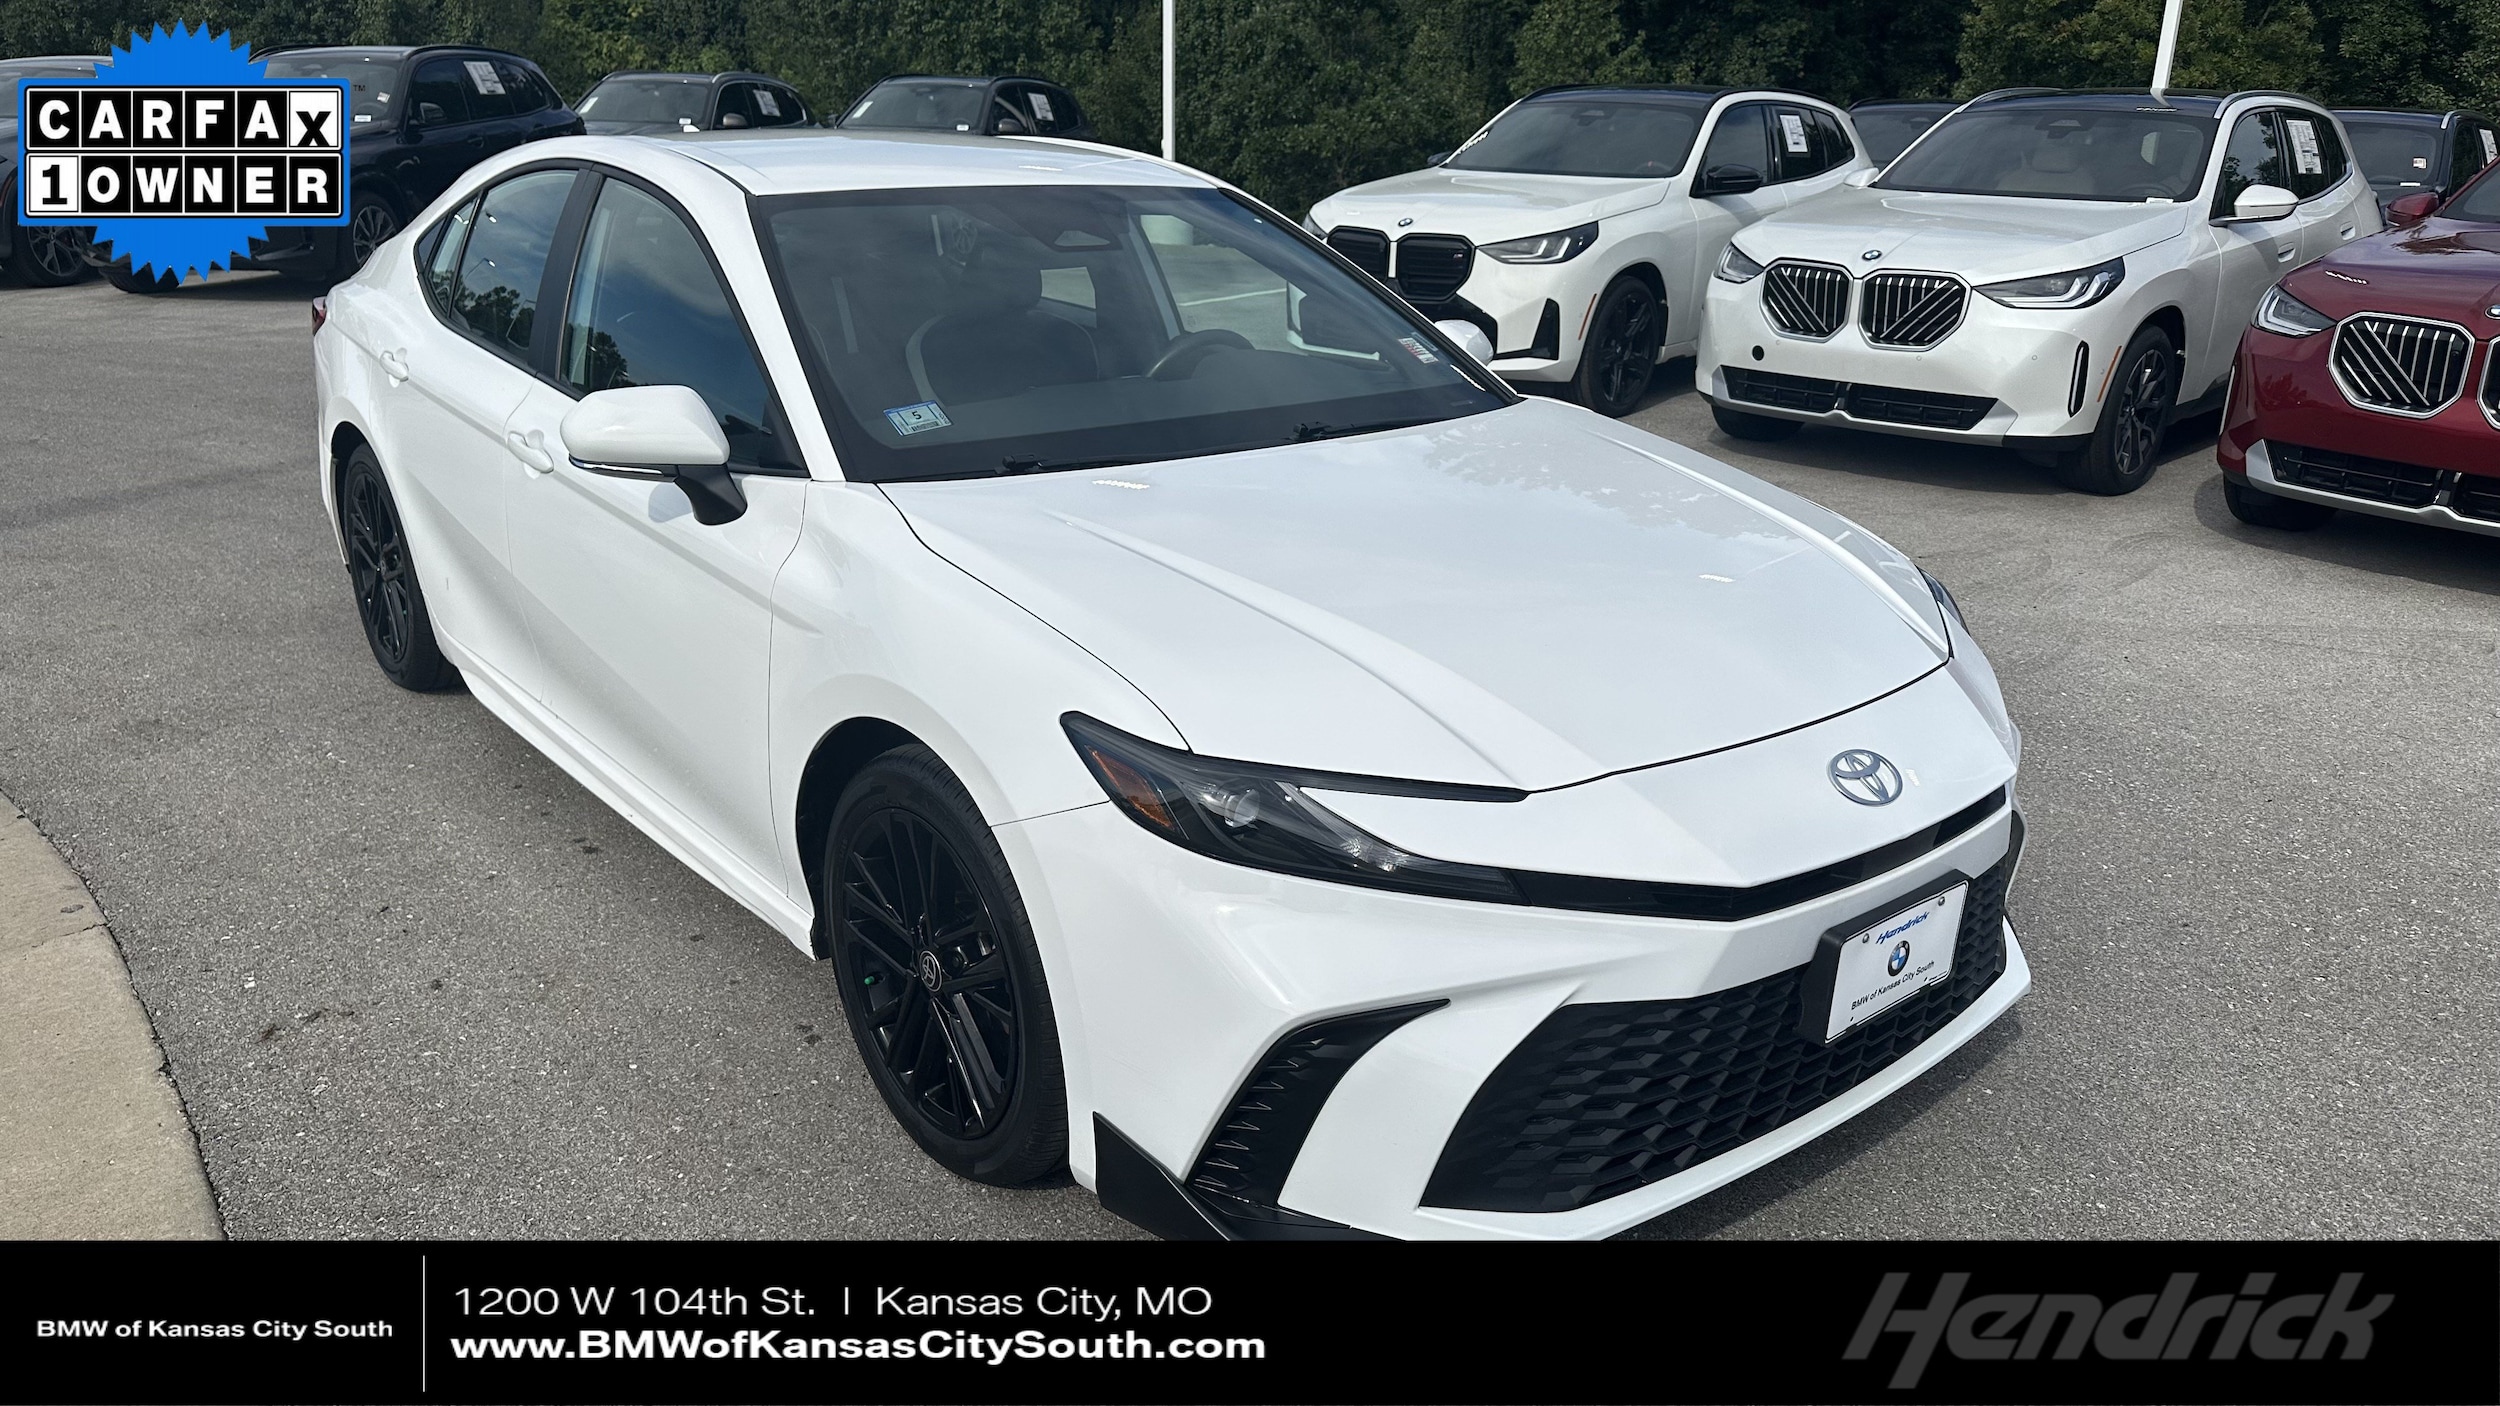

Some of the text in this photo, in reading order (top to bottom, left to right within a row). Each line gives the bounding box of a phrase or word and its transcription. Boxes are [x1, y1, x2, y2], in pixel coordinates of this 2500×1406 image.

[911, 410, 922, 420] 5
[1875, 911, 1930, 945] Hendrick
[1851, 993, 1870, 1010] BMW
[1869, 989, 1878, 1000] of
[1877, 979, 1901, 996] Kansas
[1902, 971, 1916, 983] City
[1915, 960, 1934, 976] South
